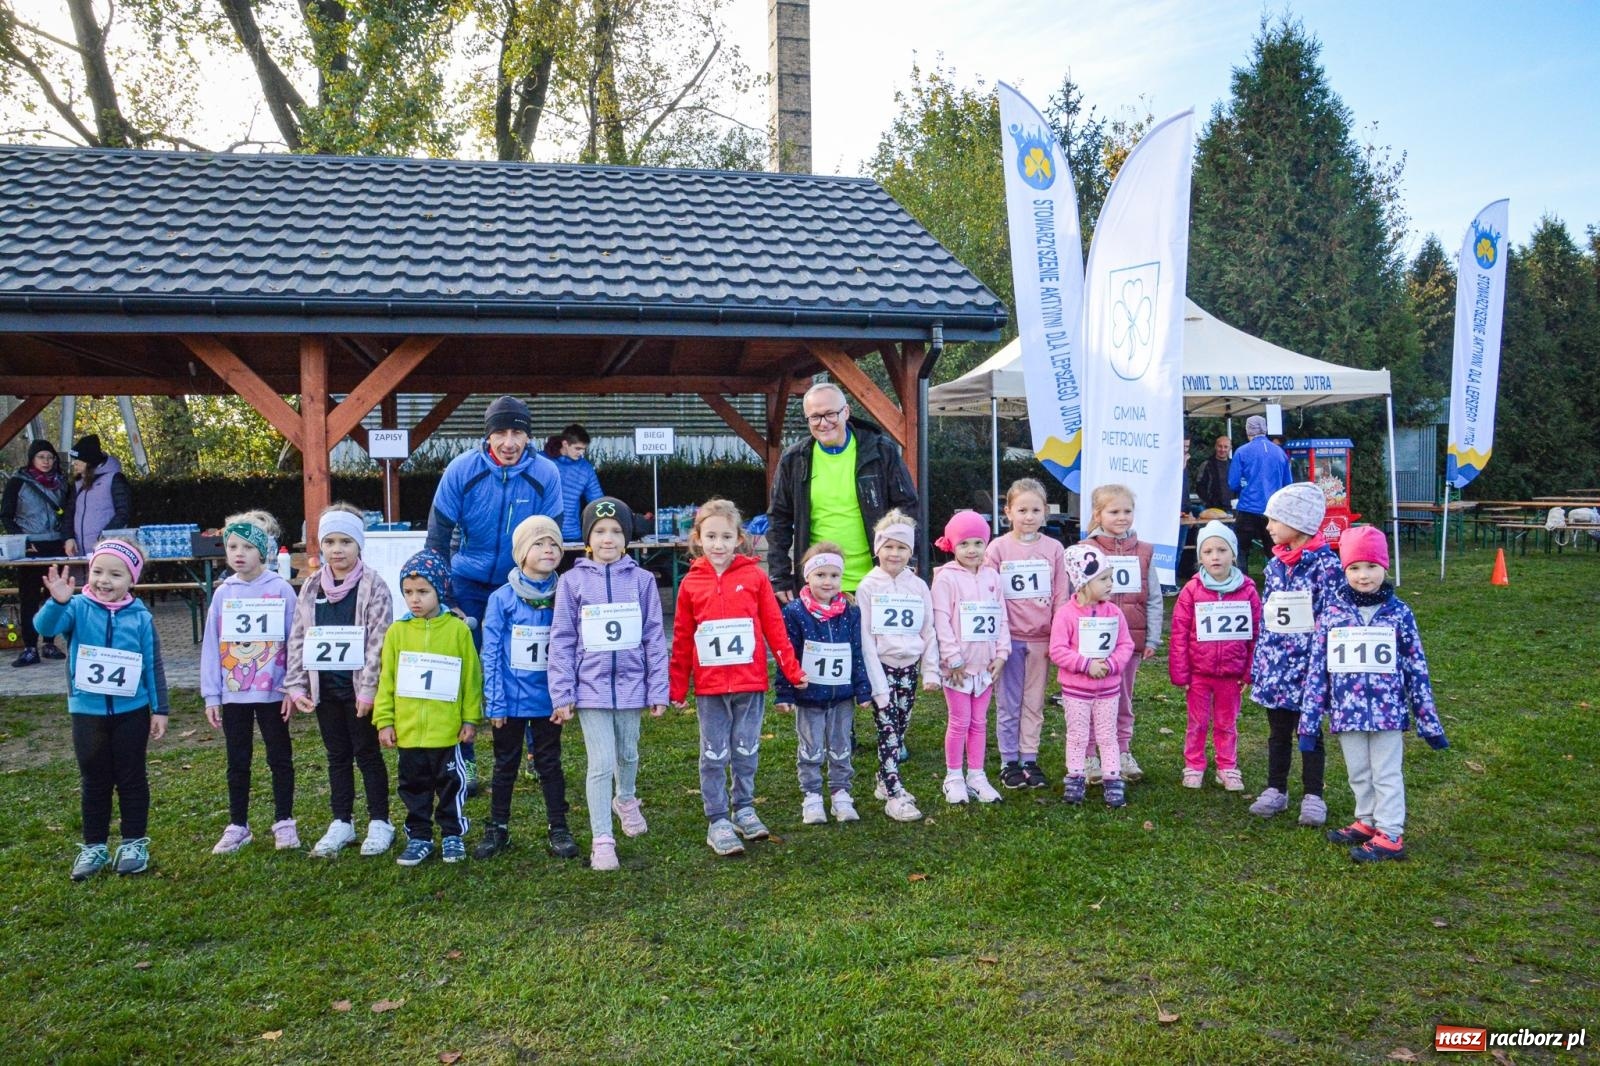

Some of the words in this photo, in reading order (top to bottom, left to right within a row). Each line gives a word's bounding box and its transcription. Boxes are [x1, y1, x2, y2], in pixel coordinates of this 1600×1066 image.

[1033, 199, 1059, 283] STOWARZYSZENIE
[1040, 286, 1063, 328] AKTYWNI
[1472, 273, 1490, 336] STOWARZYSZENIE
[1045, 330, 1070, 352] DLA
[1050, 351, 1079, 401] LEPSZEGO
[1182, 375, 1212, 390] TYWNI
[1219, 375, 1239, 390] DLA
[1246, 375, 1295, 391] LEPSZEGO
[1303, 375, 1332, 391] JUTRA
[1060, 404, 1083, 436] JUTRA
[1113, 405, 1146, 421] GMINA
[374, 433, 403, 442] ZAPISY
[643, 430, 665, 439] BIEGI
[1101, 430, 1161, 449] PIETROWICE
[641, 443, 668, 452] DZIECI
[1108, 455, 1149, 475] WIELKIE
[1010, 573, 1039, 592] 61
[235, 613, 268, 634] 31
[883, 608, 914, 628] 28
[972, 614, 996, 633] 23
[1200, 614, 1250, 634] 122
[1276, 607, 1291, 626] 5
[604, 620, 623, 642] 9
[708, 634, 745, 658] 14
[1098, 632, 1112, 651] 2
[315, 641, 351, 663] 27
[1333, 642, 1393, 665] 116
[87, 663, 127, 688] 34
[814, 657, 844, 677] 15
[419, 669, 433, 691] 1
